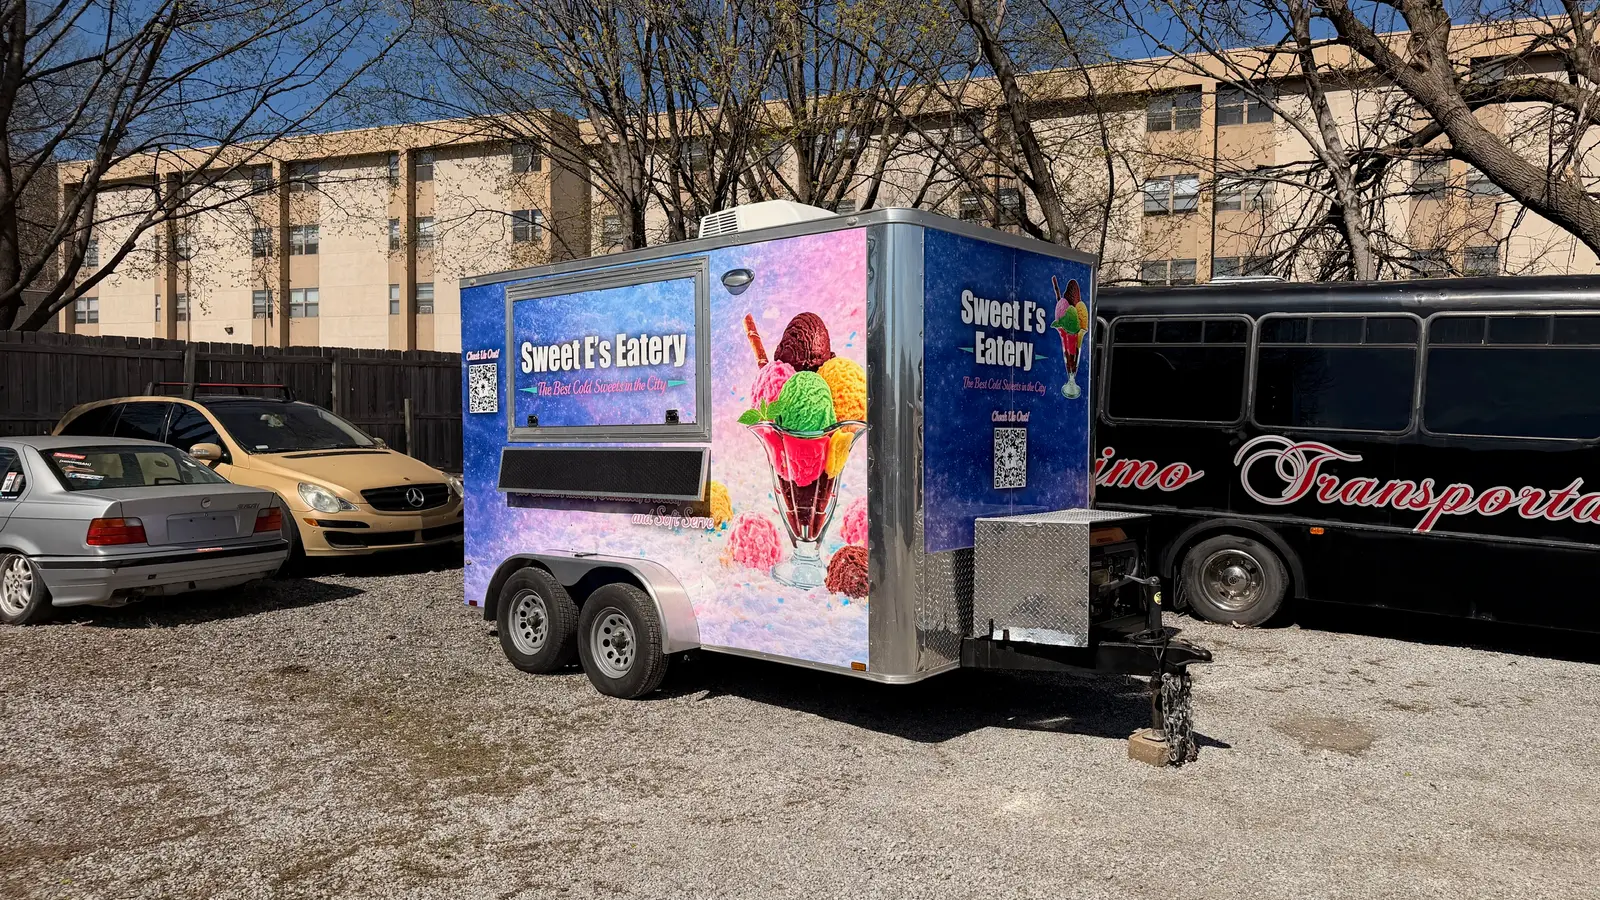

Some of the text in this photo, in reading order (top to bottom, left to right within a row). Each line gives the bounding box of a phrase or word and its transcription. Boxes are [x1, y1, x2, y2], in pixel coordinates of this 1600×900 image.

[961, 289, 1046, 334] Sweet E's
[521, 333, 687, 374] Sweet E's Eatery
[975, 330, 1034, 372] Eatery
[537, 375, 667, 396] The Best Cold Sweets in the City
[963, 376, 1047, 397] The Best Cold Sweets in the City
[631, 505, 715, 530] and Soft Serve
